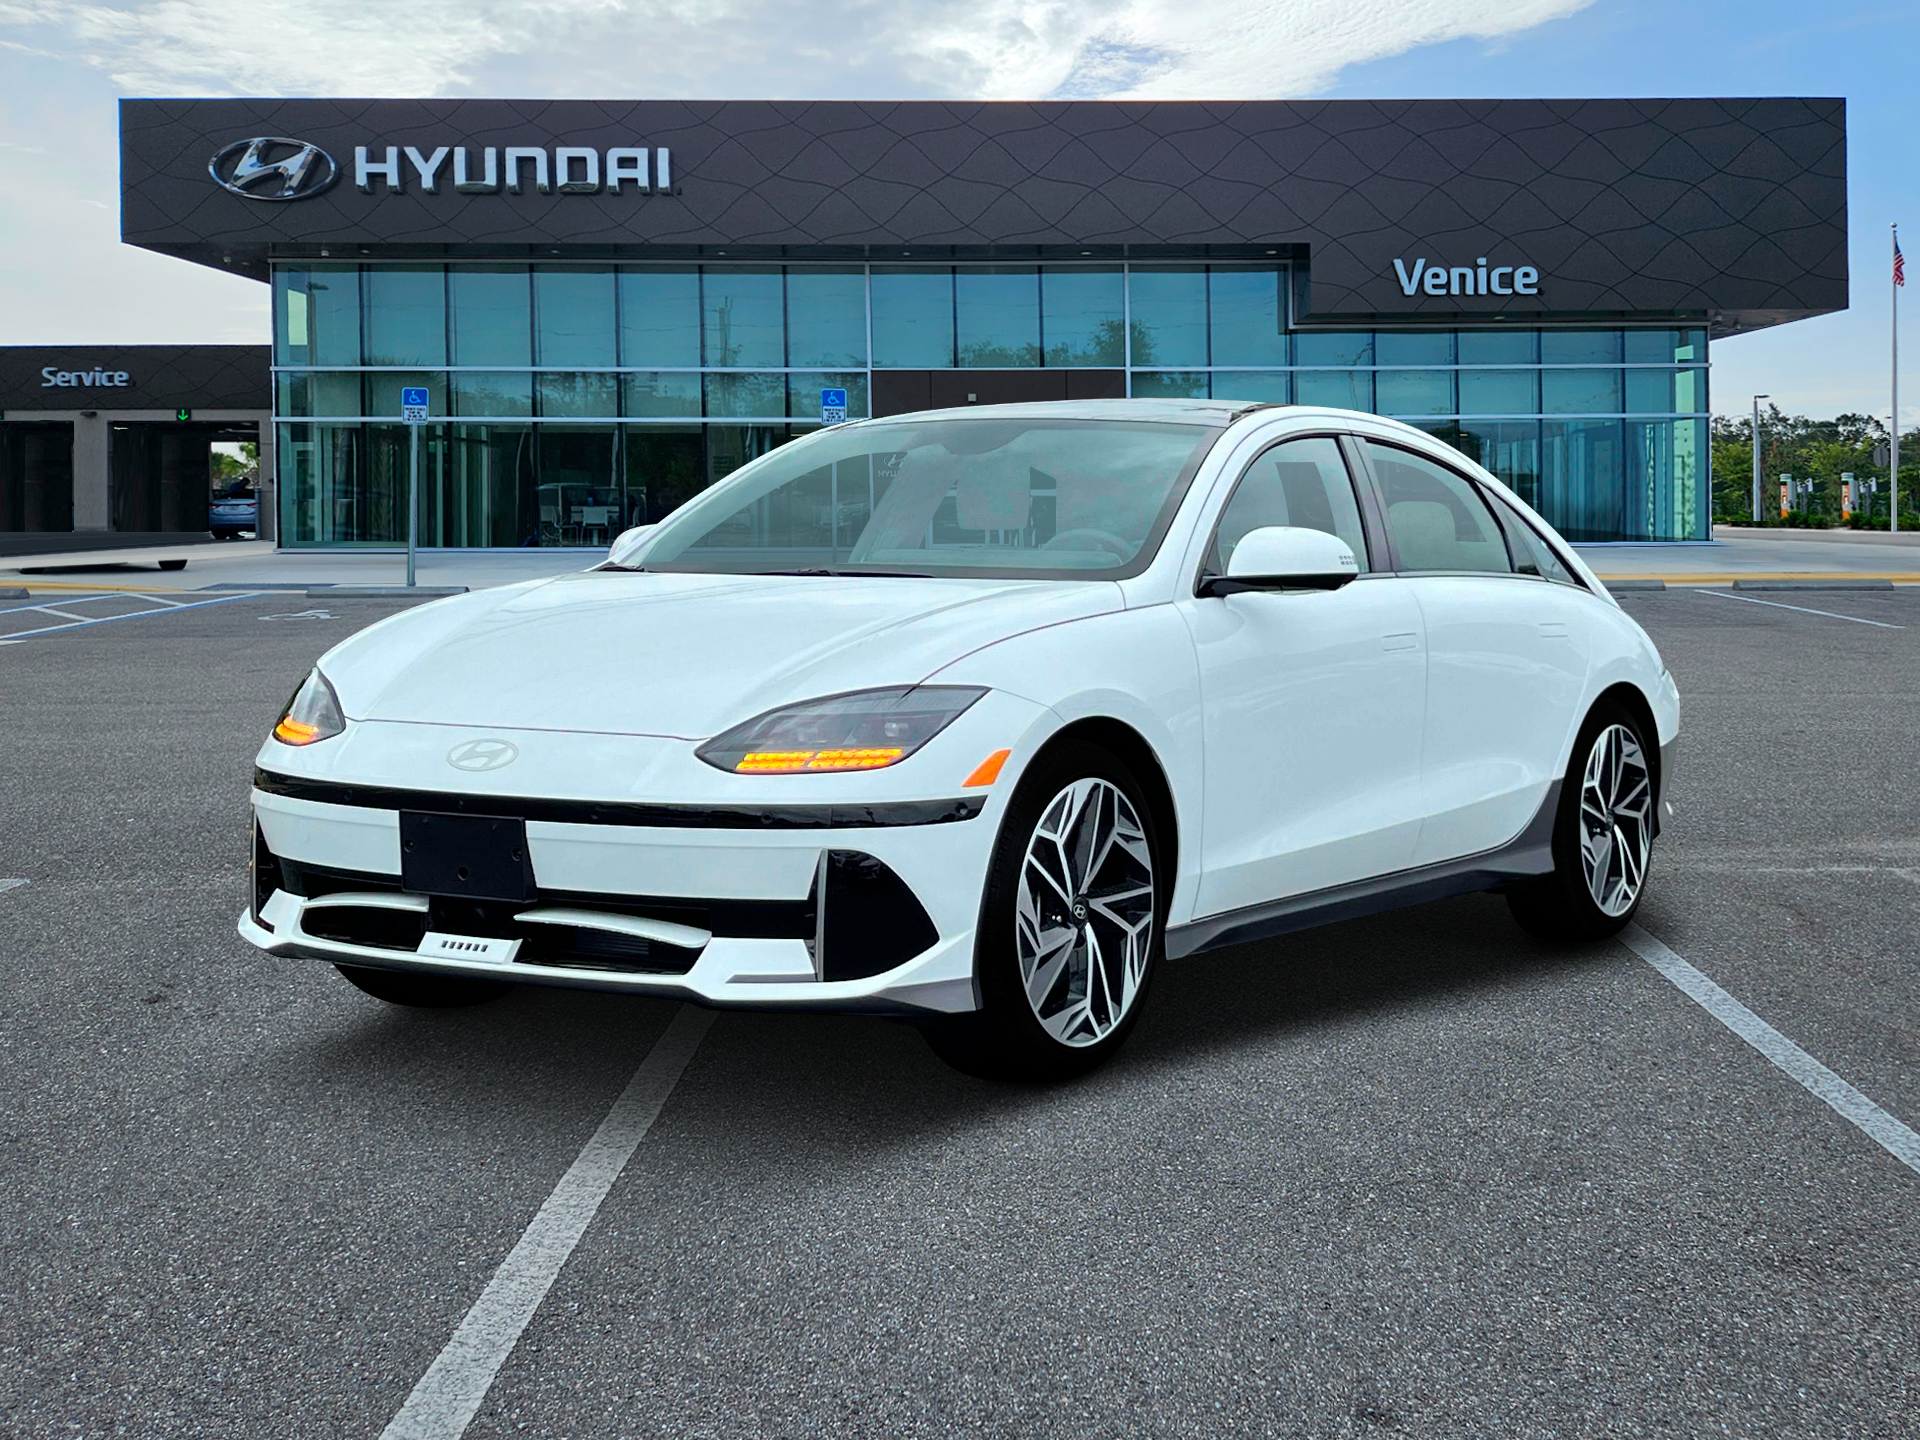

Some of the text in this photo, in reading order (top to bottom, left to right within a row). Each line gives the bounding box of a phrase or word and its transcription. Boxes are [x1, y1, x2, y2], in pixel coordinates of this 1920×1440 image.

[355, 146, 671, 194] HYUNDAI
[1393, 257, 1539, 296] Venice
[41, 366, 130, 387] Service
